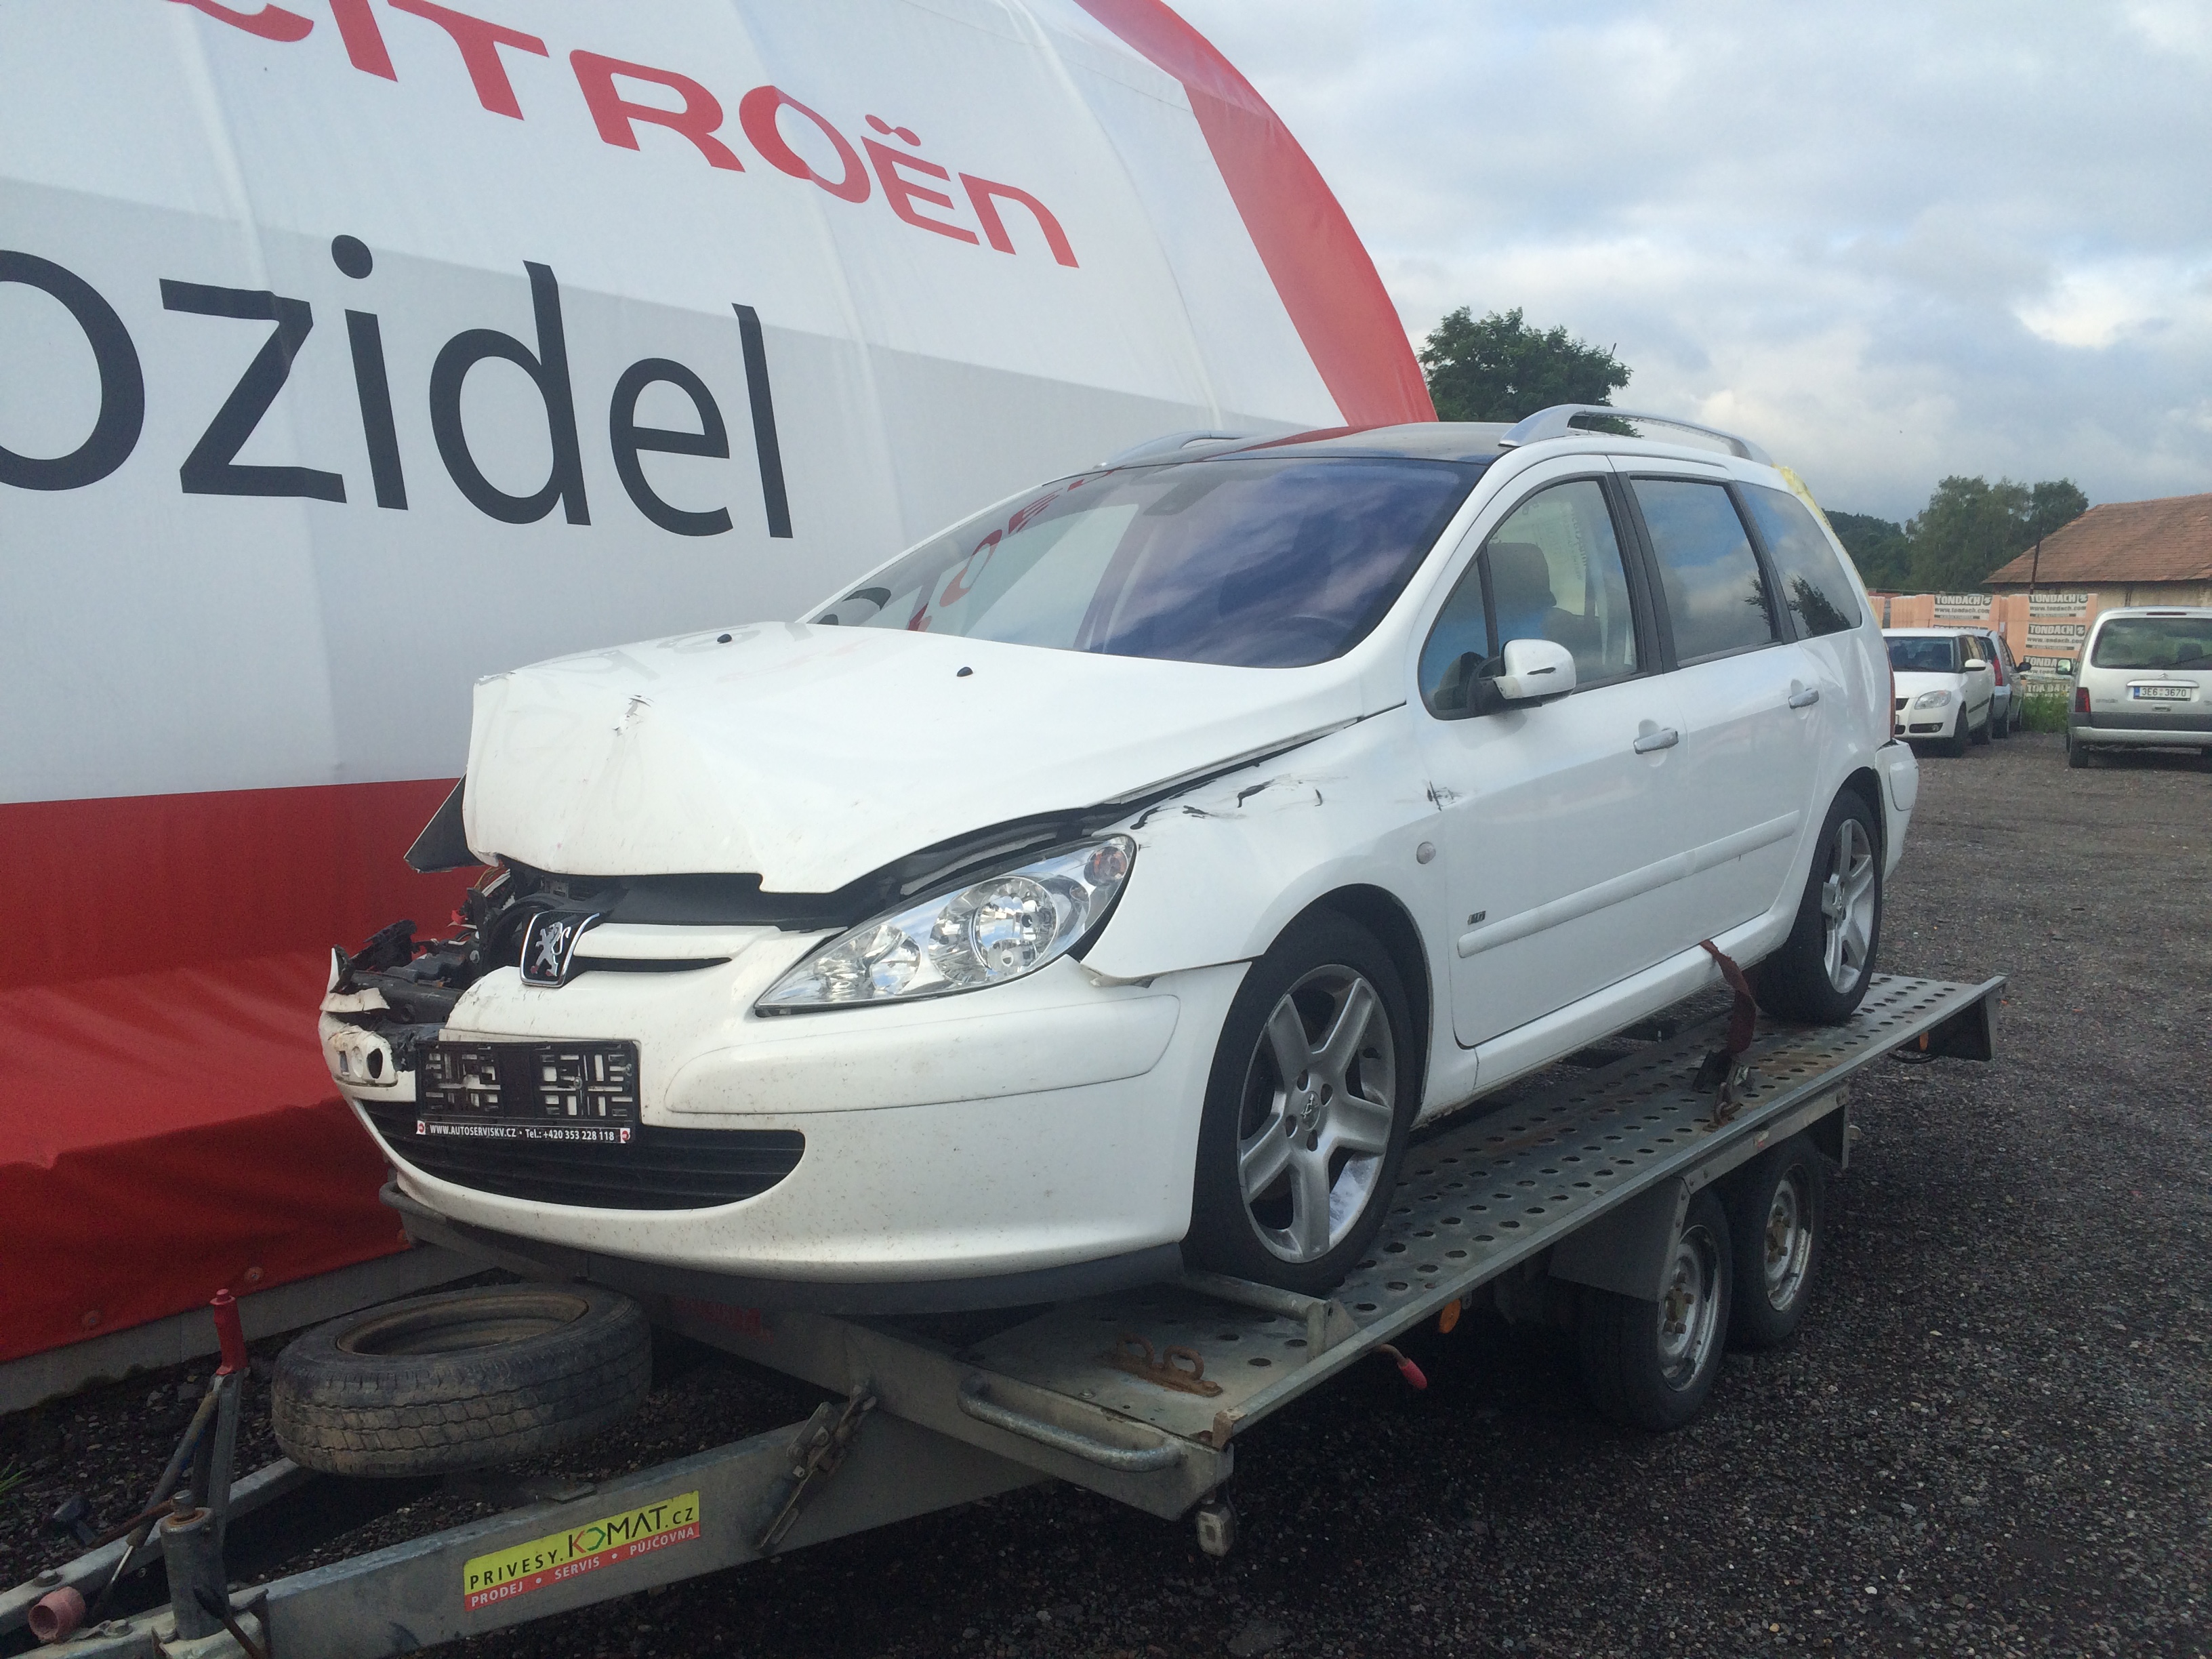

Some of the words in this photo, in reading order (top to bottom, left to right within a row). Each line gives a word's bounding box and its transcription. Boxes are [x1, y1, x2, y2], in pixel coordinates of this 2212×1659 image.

[167, 0, 1080, 269] ITROËN
[0, 234, 793, 539] ozidel
[1936, 595, 1980, 605] TONDACH
[2030, 594, 2076, 602] TONDACH
[2030, 625, 2074, 635] TONDACH
[2024, 656, 2057, 667] TONDA
[2142, 688, 2158, 696] 3E6
[2165, 689, 2187, 697] 3670
[430, 1124, 517, 1137] WWW.AUTOSERVISKV.CZ
[544, 1130, 563, 1139] +420
[565, 1130, 579, 1140] 353
[581, 1130, 597, 1140] 228
[599, 1131, 614, 1141] 118
[471, 1581, 523, 1607] PRODEJ
[554, 1556, 600, 1580] SERVIS
[630, 1526, 694, 1555] PŮJČOVNA
